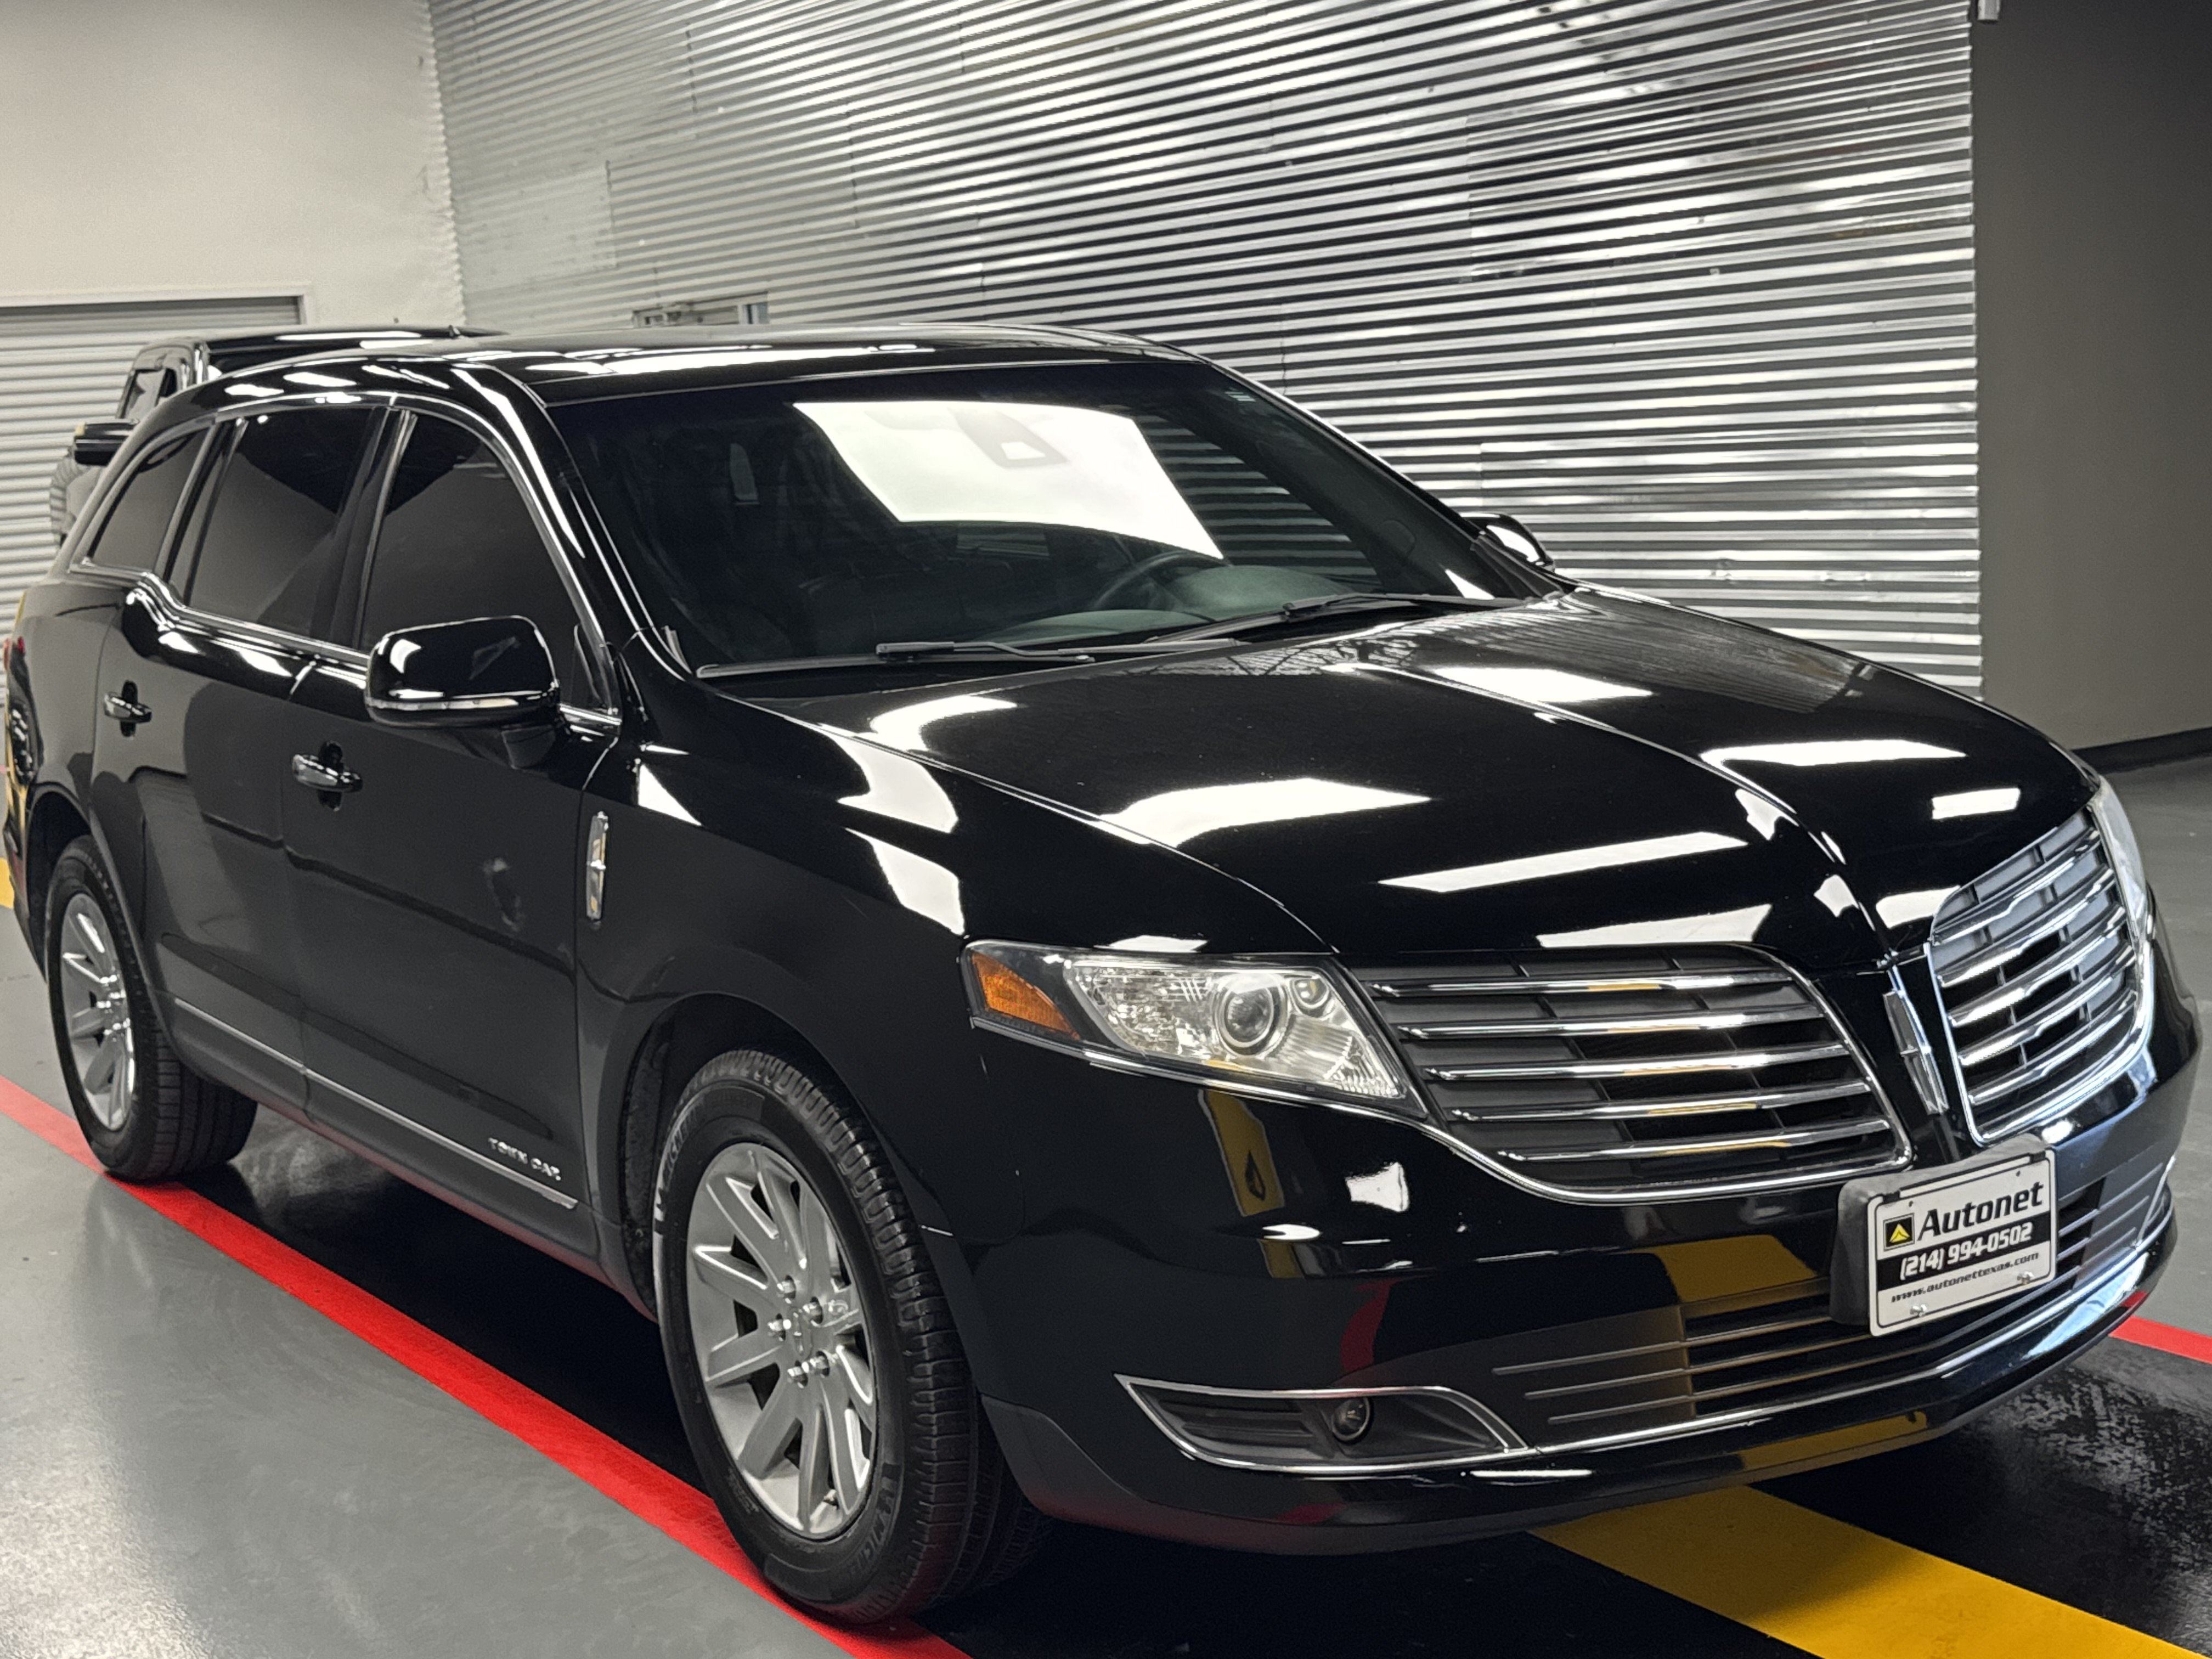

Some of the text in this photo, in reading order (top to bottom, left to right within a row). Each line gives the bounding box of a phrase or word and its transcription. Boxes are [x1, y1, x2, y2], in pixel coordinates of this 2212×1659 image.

[1917, 1181, 2044, 1240] Autonet
[1891, 1252, 2039, 1303] www.autonettexas.com
[1900, 1222, 2033, 1280] (214) 994-0502
